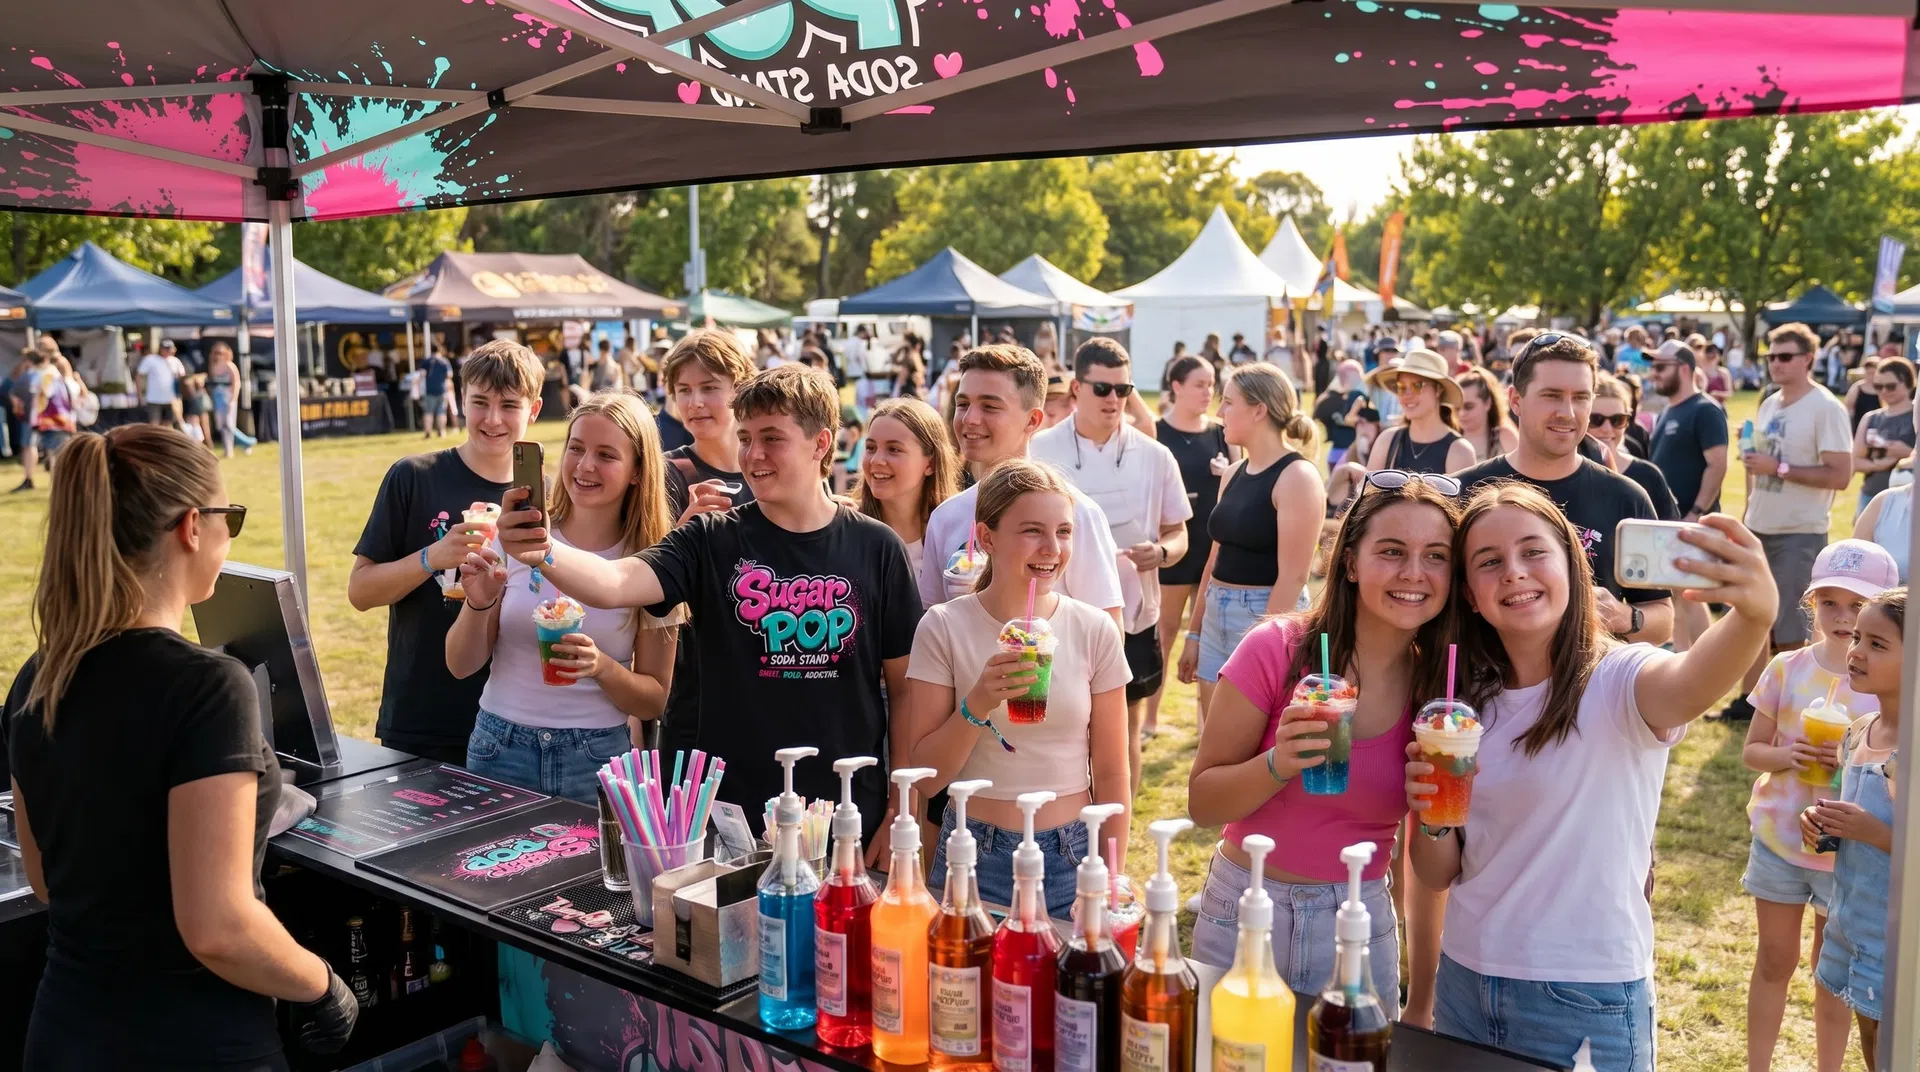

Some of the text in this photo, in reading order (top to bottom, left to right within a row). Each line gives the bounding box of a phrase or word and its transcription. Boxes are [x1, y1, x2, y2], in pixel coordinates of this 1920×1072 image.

[735, 568, 848, 621] Sugar
[761, 607, 853, 652] POP
[770, 653, 829, 666] SODA STAND
